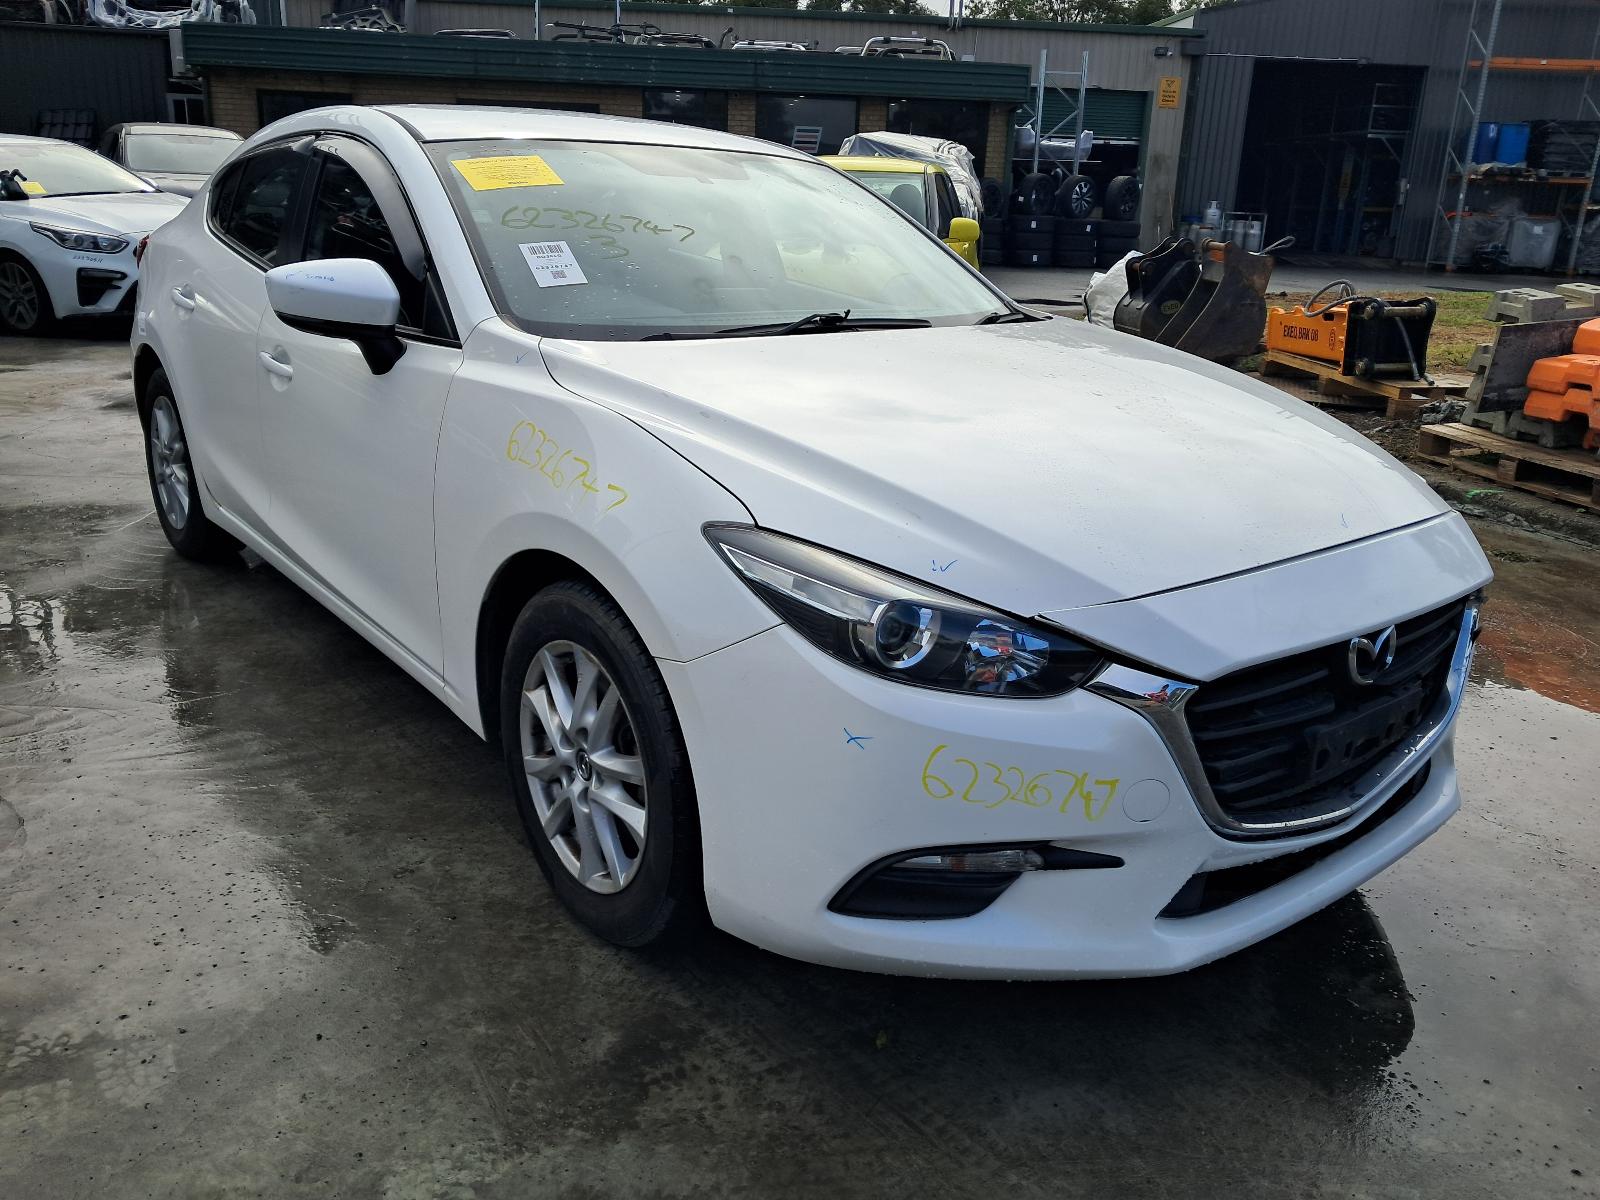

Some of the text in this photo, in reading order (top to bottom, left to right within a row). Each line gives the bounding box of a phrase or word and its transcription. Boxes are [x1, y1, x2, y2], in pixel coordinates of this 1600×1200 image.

[501, 206, 696, 242] 62326747
[588, 235, 630, 260] 3
[1298, 327, 1311, 341] BRK
[506, 420, 629, 511] 62326747
[921, 744, 1120, 822] 62326747
